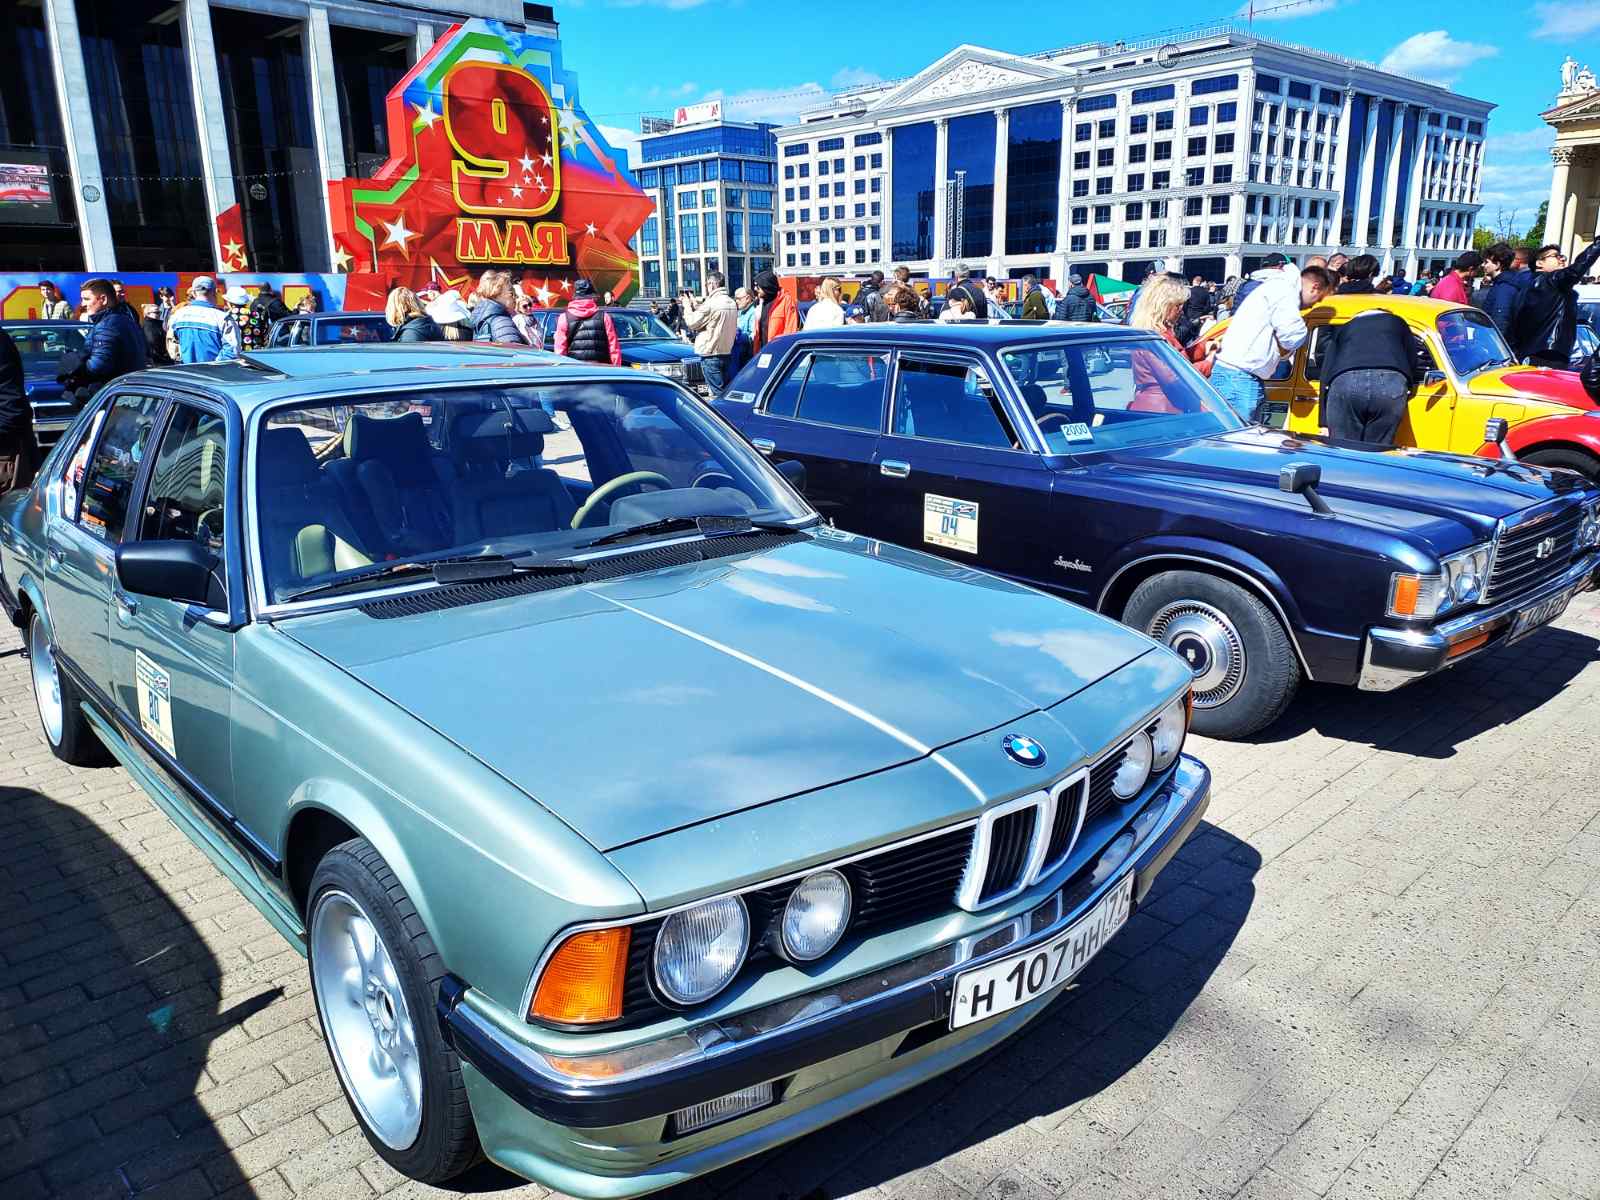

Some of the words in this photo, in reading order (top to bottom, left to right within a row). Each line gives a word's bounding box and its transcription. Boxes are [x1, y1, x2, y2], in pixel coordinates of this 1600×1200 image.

[443, 60, 561, 217] 9
[456, 218, 570, 265] МАЯ
[1063, 424, 1088, 436] 2000
[941, 514, 958, 536] 04
[1108, 881, 1128, 925] 77
